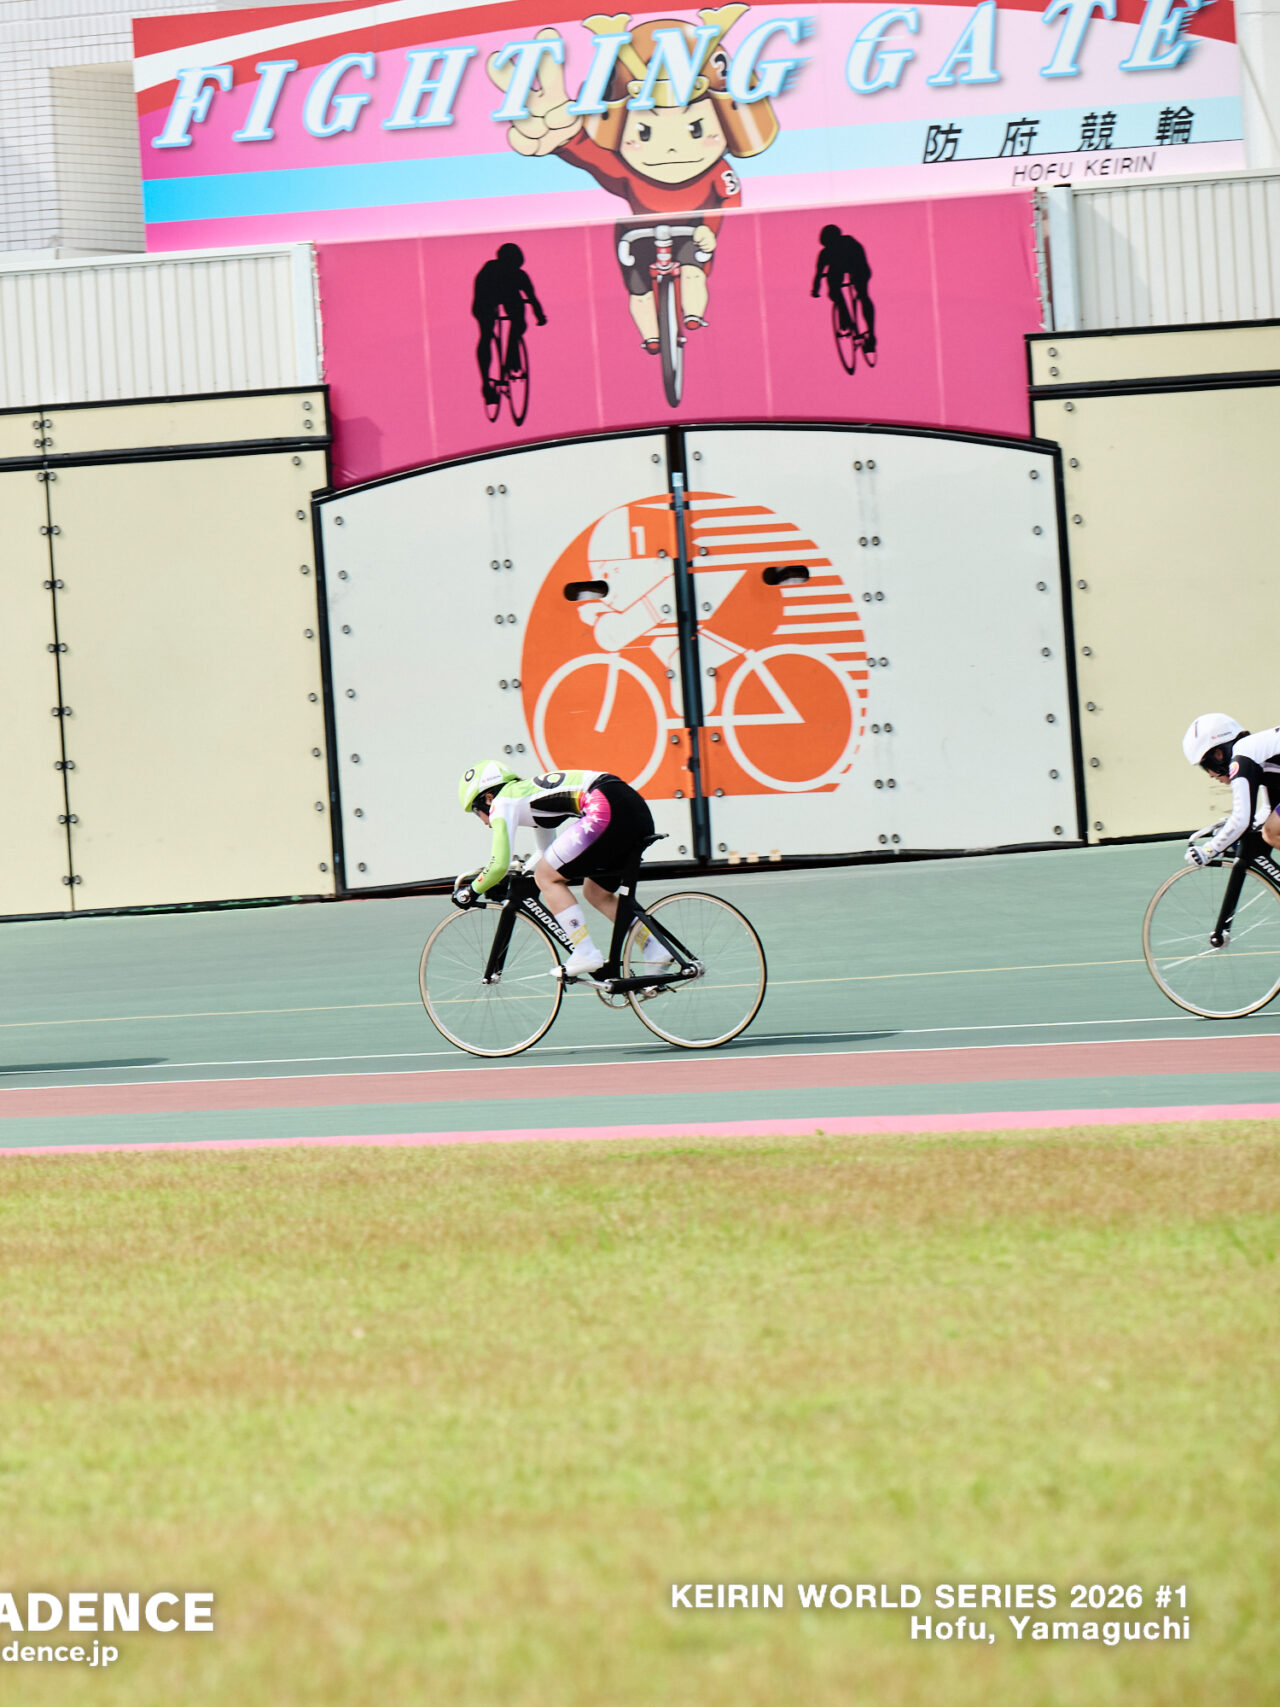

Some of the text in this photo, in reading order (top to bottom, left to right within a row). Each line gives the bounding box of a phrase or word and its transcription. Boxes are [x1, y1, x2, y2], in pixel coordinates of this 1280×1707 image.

[151, 0, 1210, 149] FIGHTING GATE
[922, 106, 1195, 164] 防府競輪
[1012, 152, 1157, 186] HOFU KEIRIN
[631, 525, 646, 556] 1
